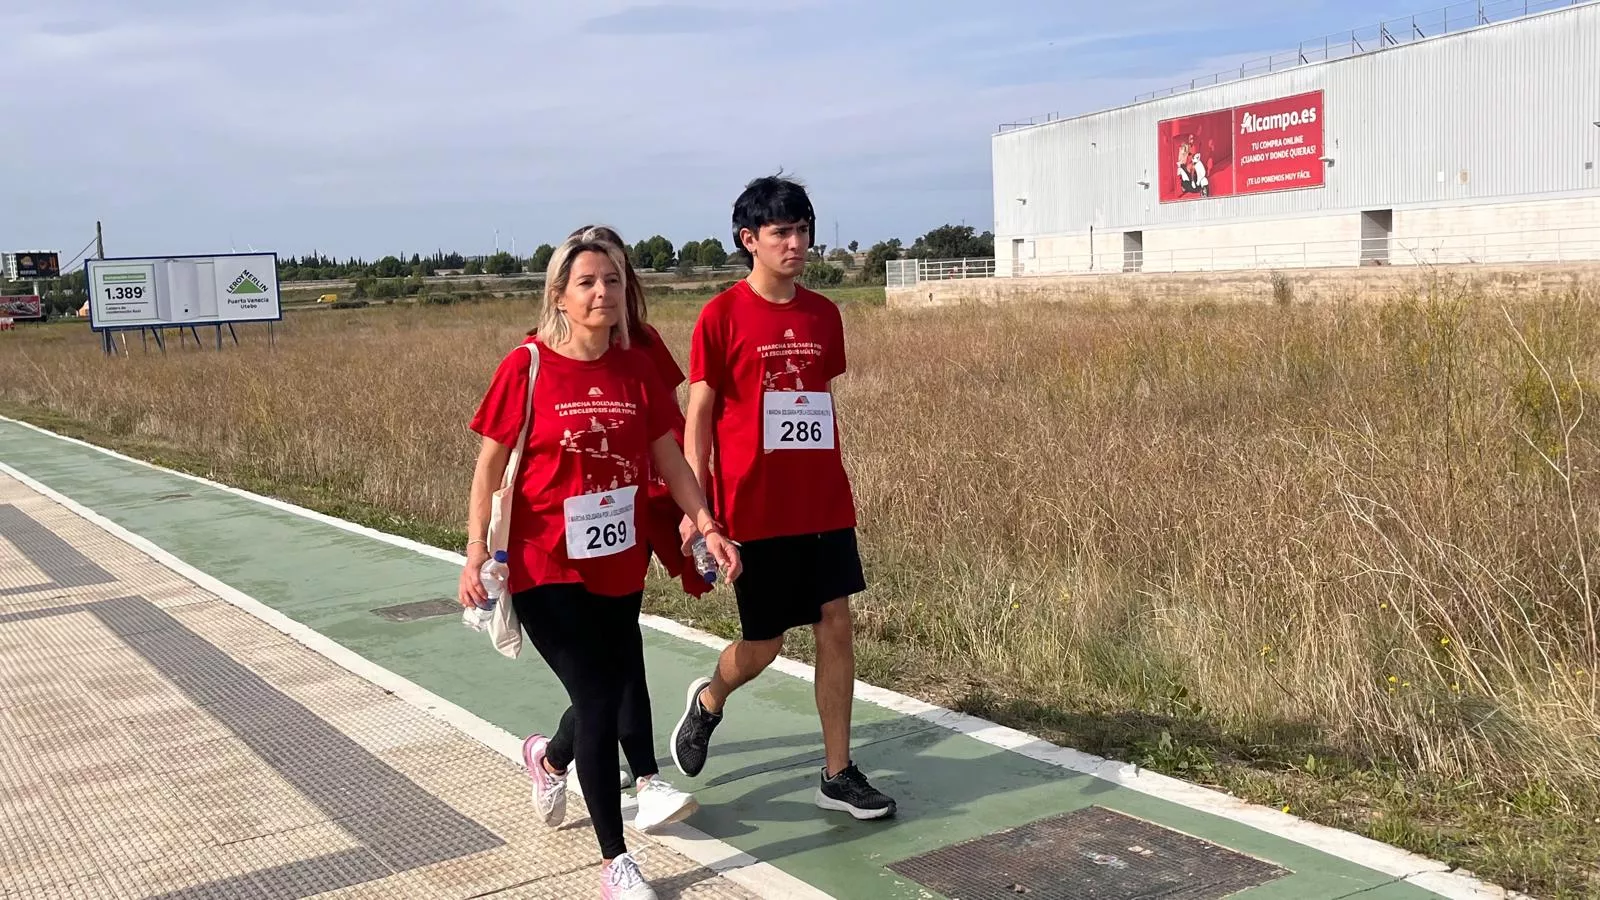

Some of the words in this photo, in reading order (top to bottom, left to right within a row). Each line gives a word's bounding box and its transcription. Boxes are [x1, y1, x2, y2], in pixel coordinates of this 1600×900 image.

[1240, 107, 1316, 134] Alcampo.es
[1251, 142, 1259, 151] TU
[1260, 138, 1282, 149] COMPRA
[1283, 135, 1303, 146] ONLINE
[1264, 152, 1270, 160] Y
[1254, 176, 1261, 185] LO
[1261, 173, 1285, 183] PONEMOS
[1285, 171, 1297, 181] MUY
[226, 273, 245, 294] LEROY
[242, 269, 269, 292] MERLIN
[761, 343, 786, 351] MARCHA
[560, 401, 591, 409] MARCHA
[569, 407, 607, 415] ESCLEROSIS
[608, 406, 636, 415] MÚLTIPLE
[780, 421, 822, 442] 286
[586, 520, 627, 550] 269
